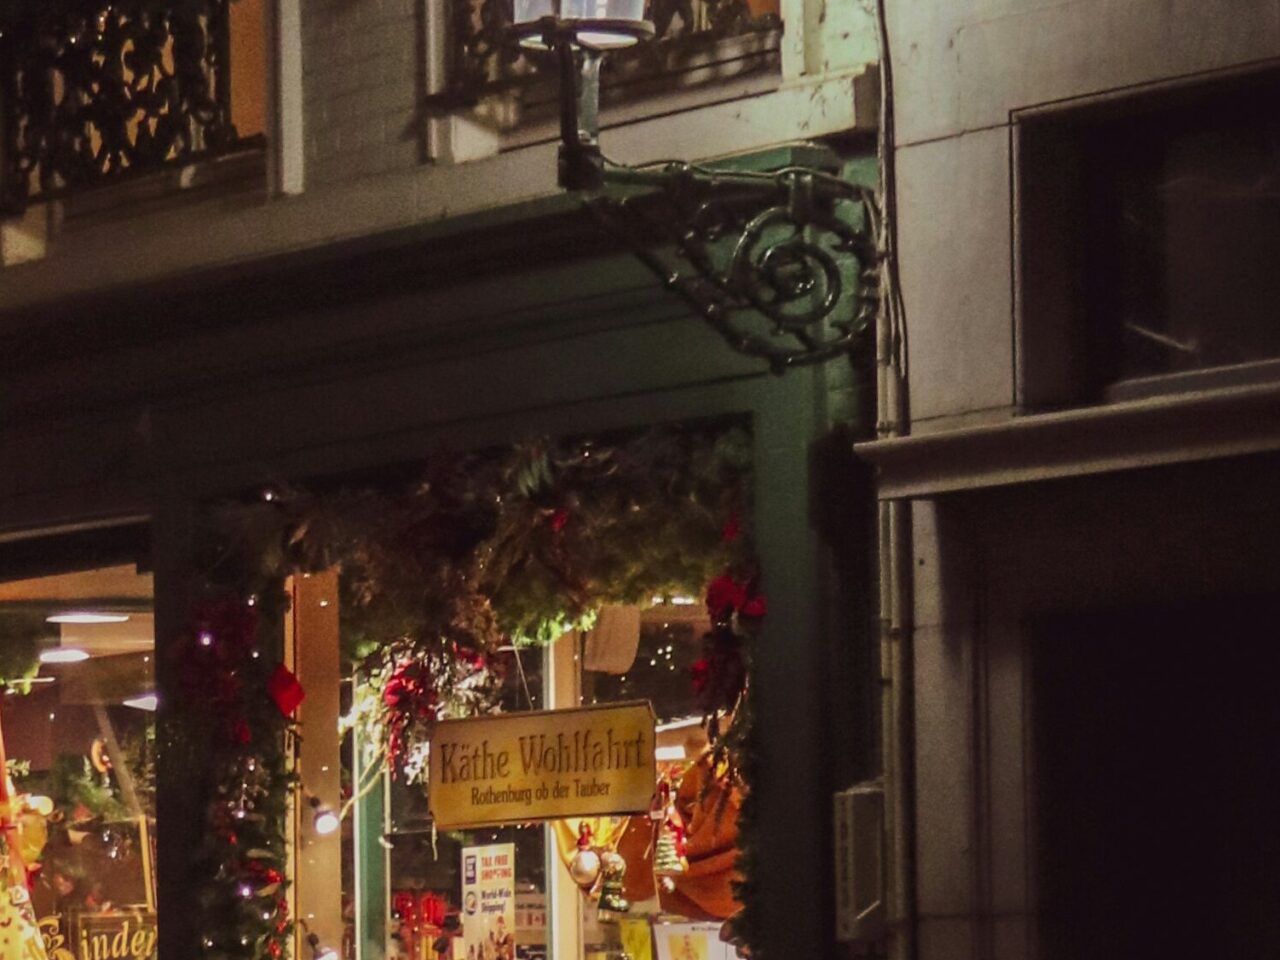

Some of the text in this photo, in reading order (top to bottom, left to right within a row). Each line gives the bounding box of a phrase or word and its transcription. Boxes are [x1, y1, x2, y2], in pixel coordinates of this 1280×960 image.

[440, 729, 646, 784] Käthe Wohlfahrt
[471, 778, 610, 805] Rothenburg ob der Tauber
[495, 854, 508, 866] FREE
